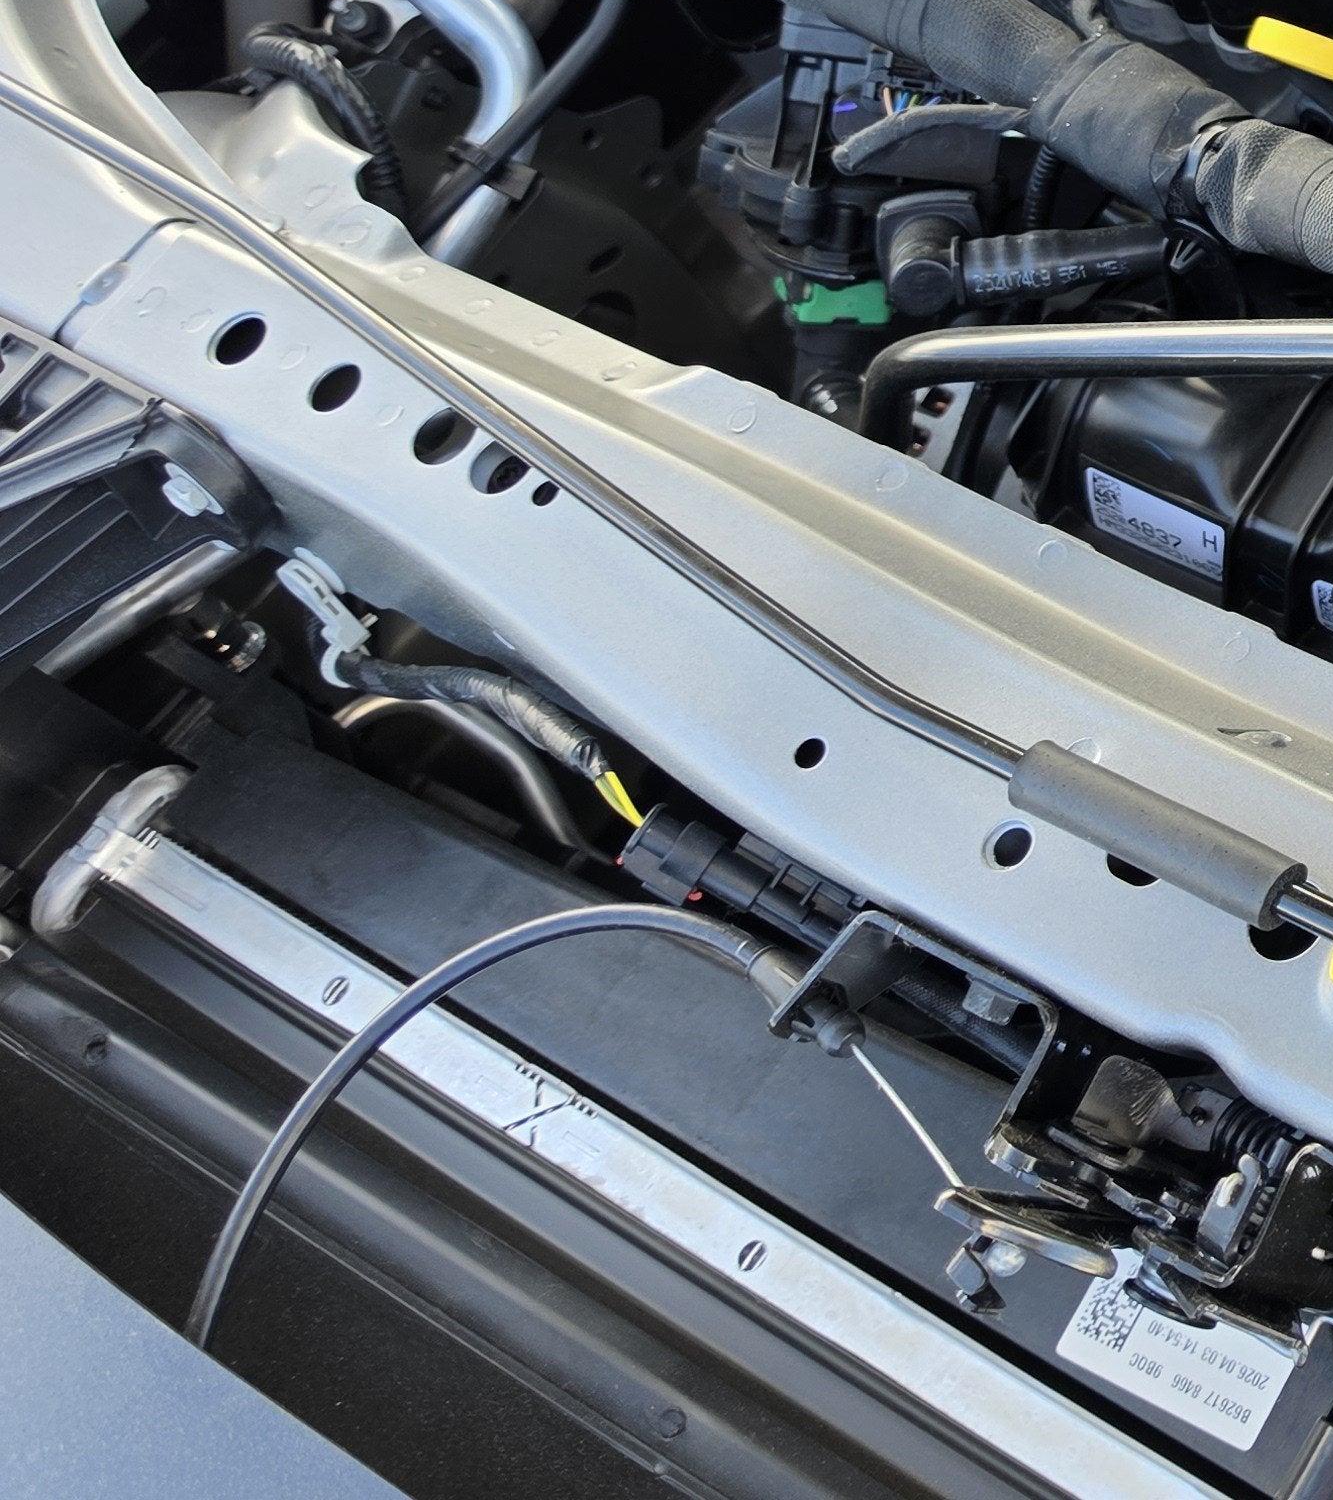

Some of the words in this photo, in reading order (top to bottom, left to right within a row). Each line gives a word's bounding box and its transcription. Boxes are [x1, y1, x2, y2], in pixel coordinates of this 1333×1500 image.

[1200, 1345, 1270, 1389] 2026.04.03
[1170, 1373, 1203, 1399] 8466
[1203, 1391, 1252, 1422] B62617
